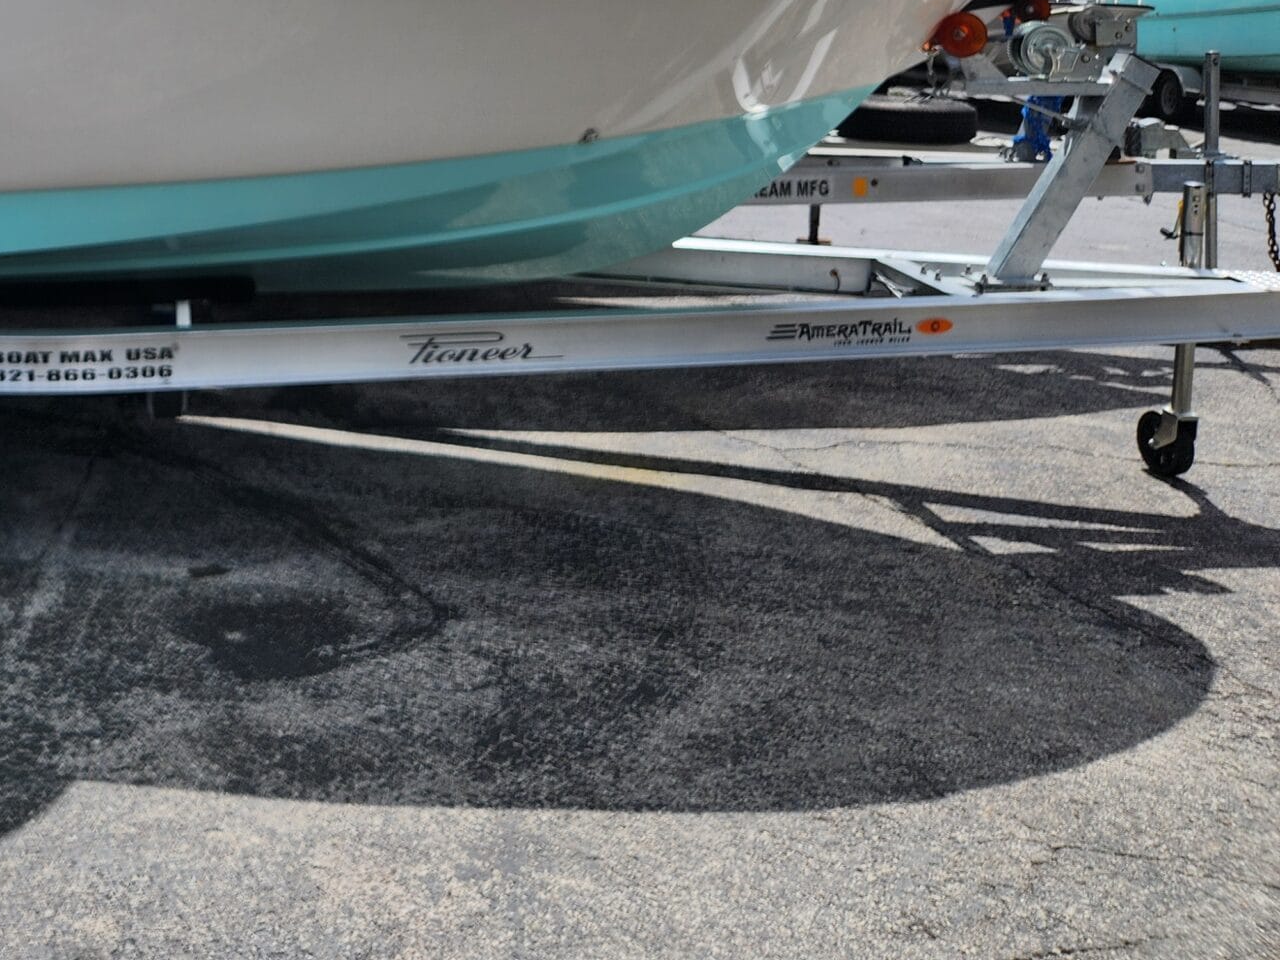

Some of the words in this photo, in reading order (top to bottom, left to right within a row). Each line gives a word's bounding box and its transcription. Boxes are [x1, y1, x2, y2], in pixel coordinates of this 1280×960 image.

[754, 181, 792, 198] EAM
[796, 180, 829, 197] MFG
[60, 349, 113, 362] MAX
[126, 346, 175, 361] USA
[400, 331, 563, 364] Pioneer
